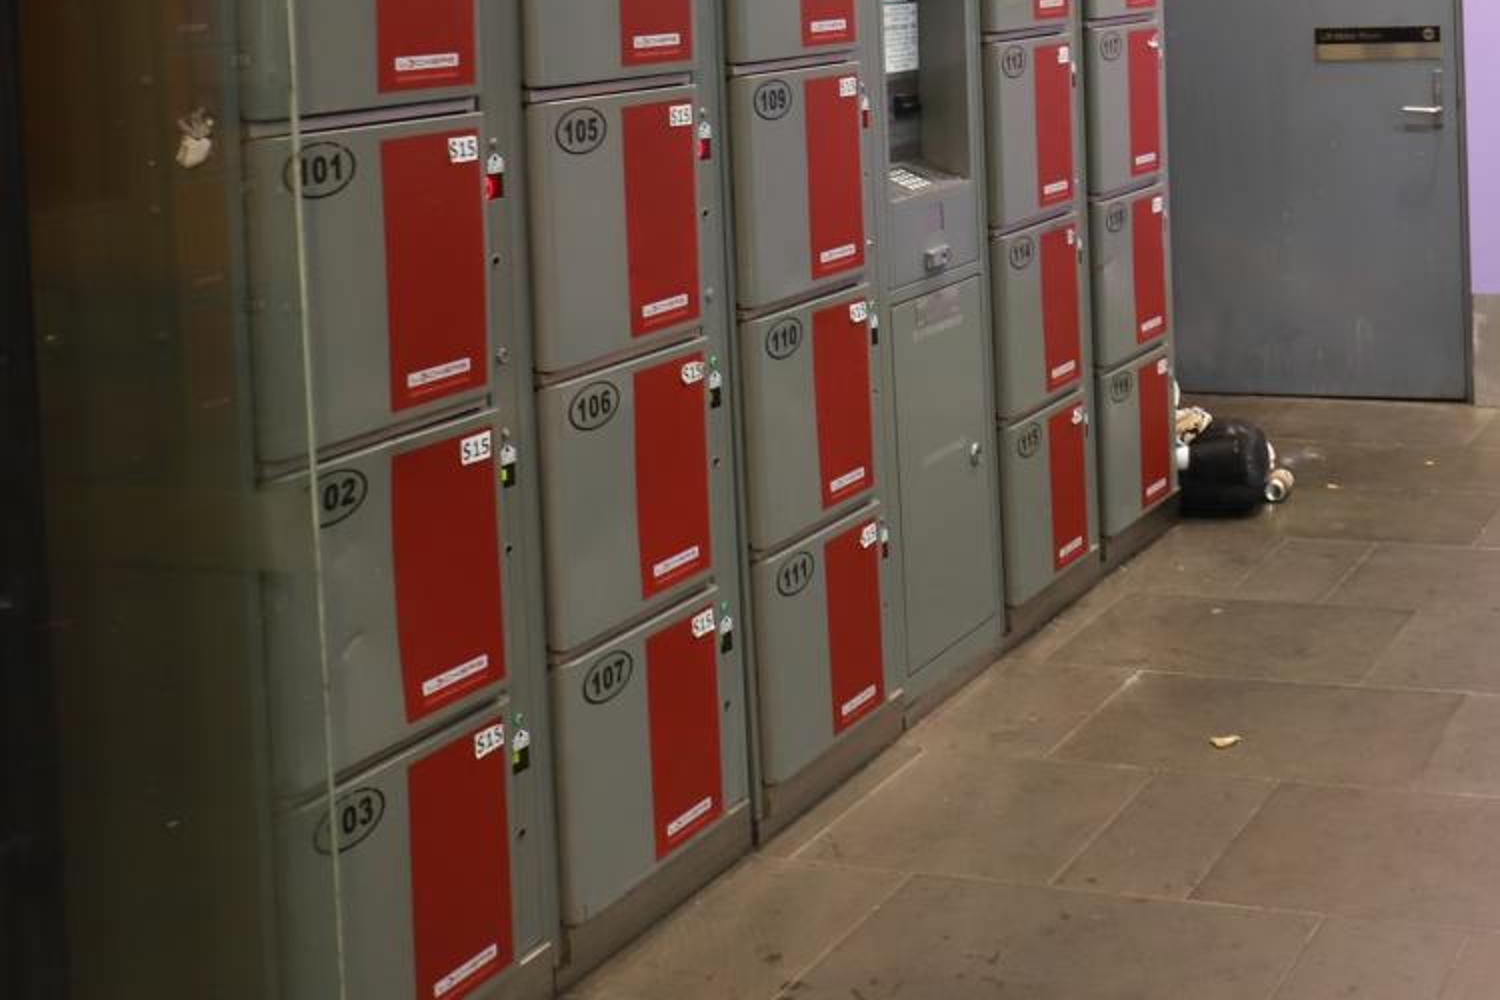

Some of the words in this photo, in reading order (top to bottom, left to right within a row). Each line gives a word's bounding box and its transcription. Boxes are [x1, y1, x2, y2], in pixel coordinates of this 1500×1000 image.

[761, 87, 787, 113] 109
[564, 117, 599, 146] 105
[301, 154, 342, 186] 101
[773, 324, 797, 353] 110
[577, 389, 612, 422] 106
[784, 557, 808, 587] 111
[591, 658, 626, 695] 107
